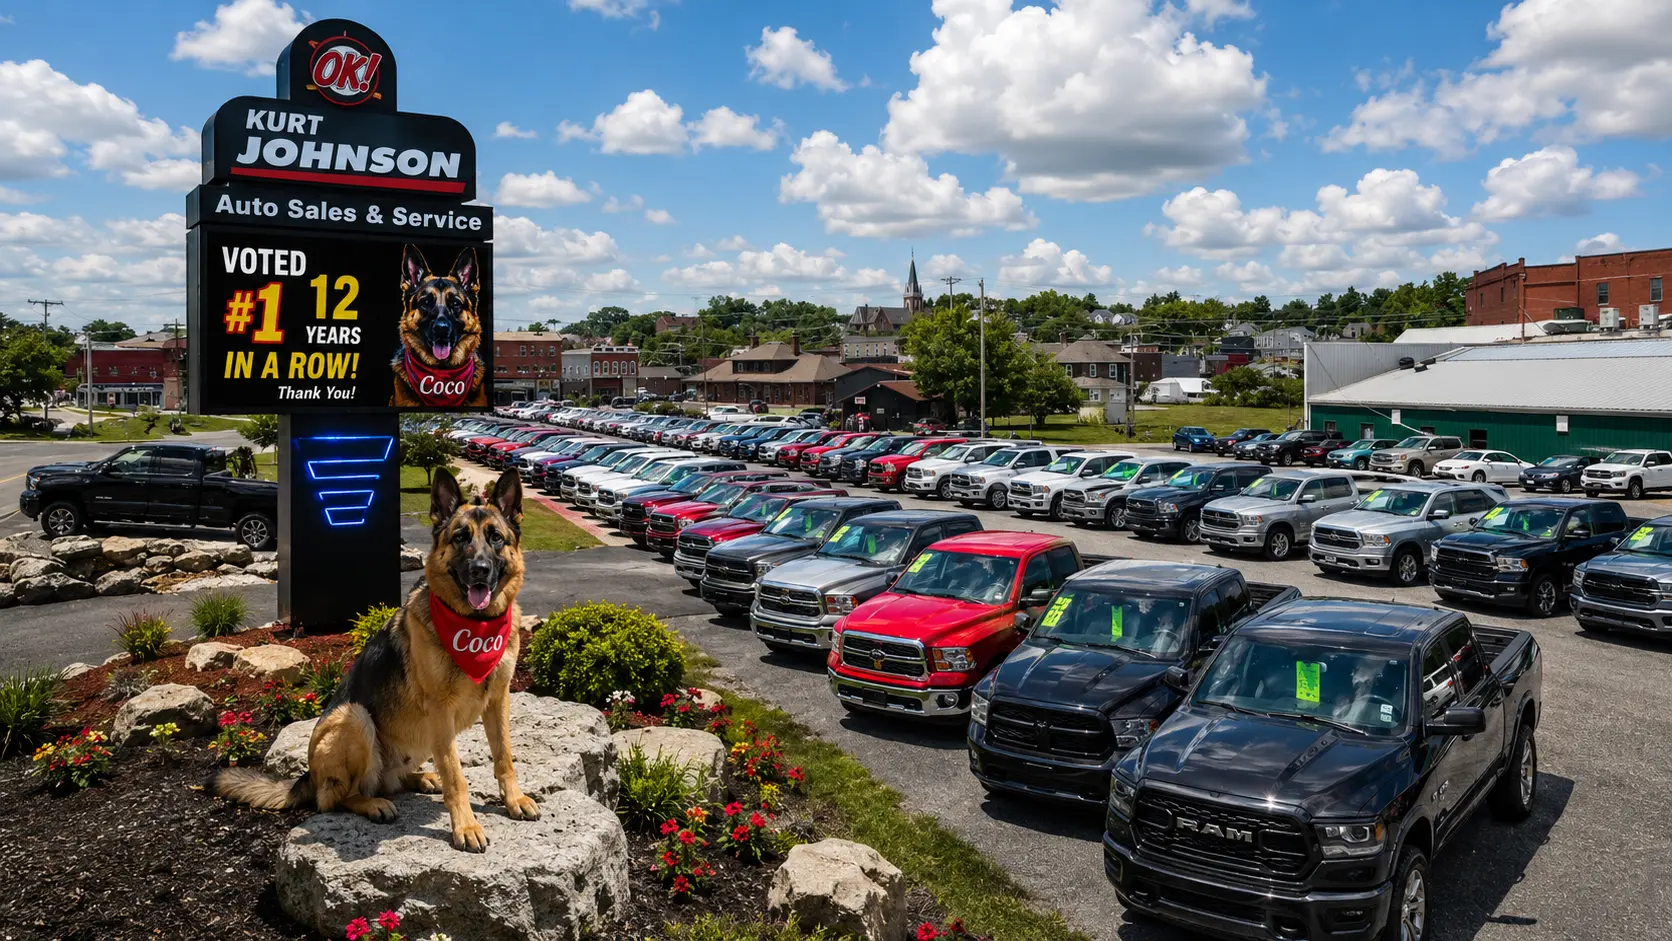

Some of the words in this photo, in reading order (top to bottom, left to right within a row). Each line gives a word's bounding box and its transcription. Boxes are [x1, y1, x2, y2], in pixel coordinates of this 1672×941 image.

[312, 52, 382, 93] OK!
[245, 108, 324, 135] KURT
[236, 136, 461, 179] JOHNSON
[215, 195, 279, 218] Auto
[288, 199, 357, 222] Sales
[366, 205, 384, 225] &
[392, 206, 482, 231] Service
[222, 246, 307, 277] VOTED
[310, 274, 360, 320] 12
[223, 281, 285, 344] #1
[306, 325, 361, 345] YEARS
[224, 351, 254, 379] IN
[260, 351, 279, 379] A
[288, 352, 360, 379] ROW!
[278, 386, 321, 400] Thank
[326, 386, 356, 400] You!
[419, 375, 465, 396] Coco
[452, 628, 503, 653] Coco
[1176, 816, 1253, 843] RAM
